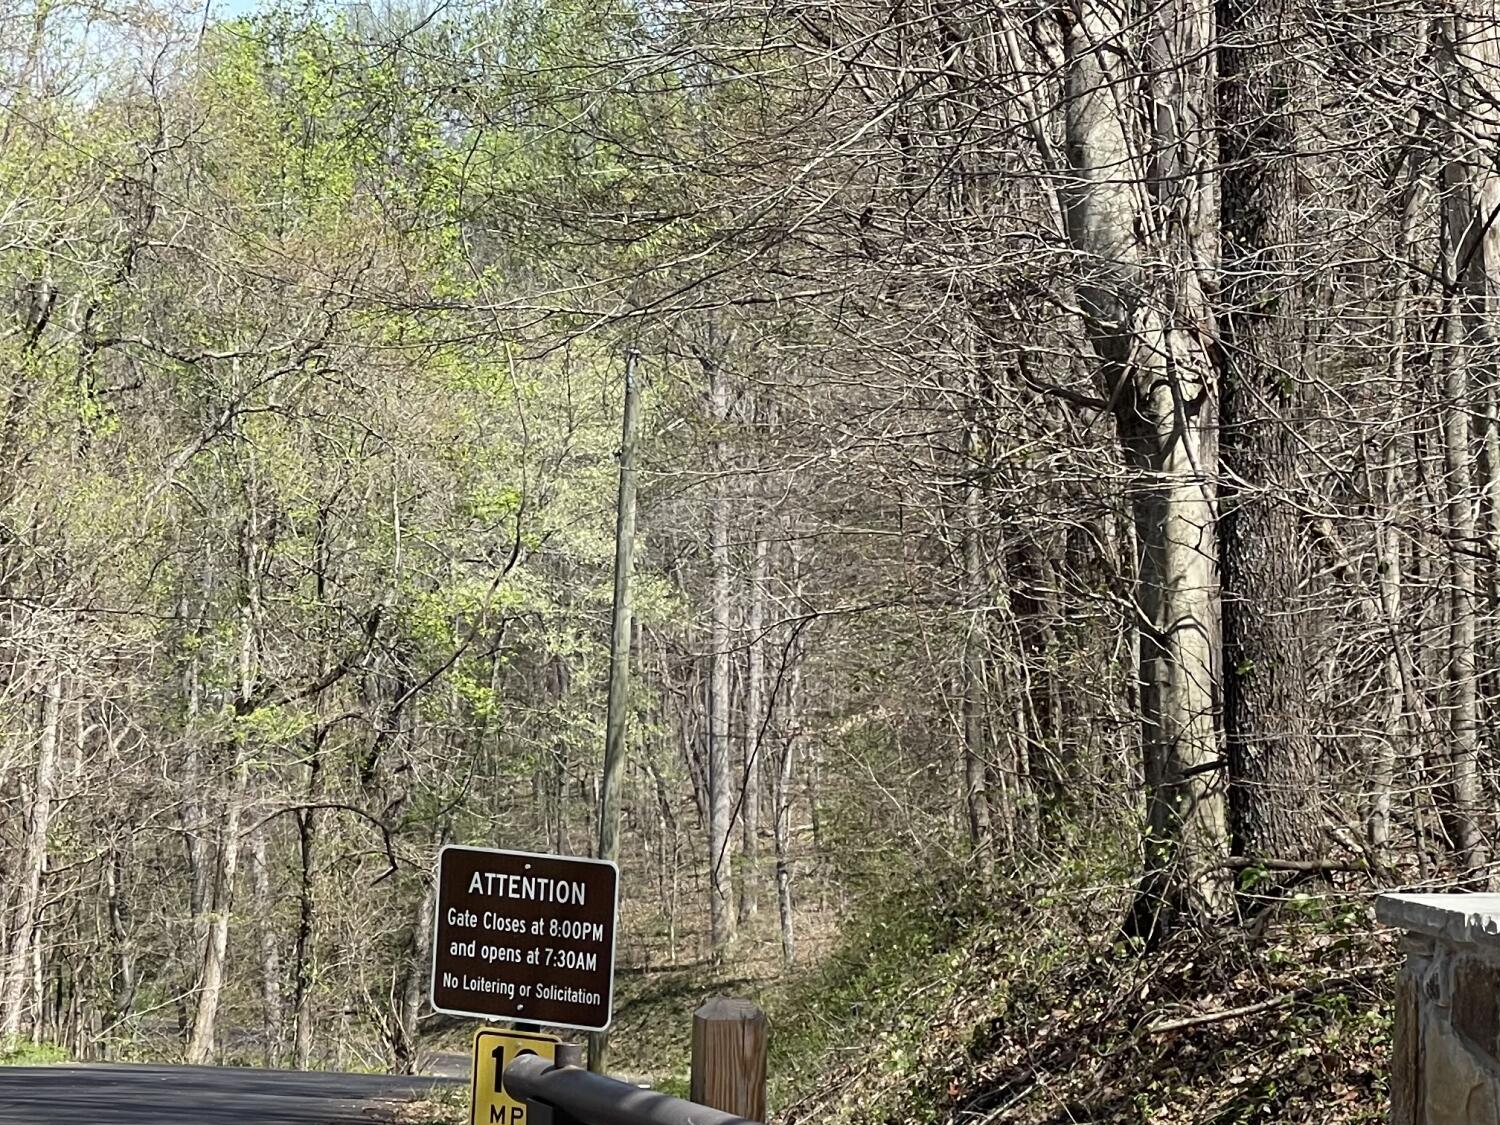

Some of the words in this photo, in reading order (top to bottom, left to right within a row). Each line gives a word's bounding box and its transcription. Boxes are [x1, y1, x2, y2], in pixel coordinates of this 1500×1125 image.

[468, 871, 585, 905] ATTENTION
[447, 907, 478, 928] Gate
[483, 911, 526, 934] Closes
[531, 918, 544, 935] at
[549, 919, 604, 942] 8:00PM
[450, 940, 476, 958] and
[481, 945, 521, 964] opens
[526, 948, 540, 965] at
[545, 948, 597, 971] 7:30AM
[443, 972, 459, 989] No
[463, 974, 515, 1000] Loitering
[519, 984, 532, 997] or
[535, 983, 601, 1006] Solicitation
[491, 1045, 540, 1093] 1
